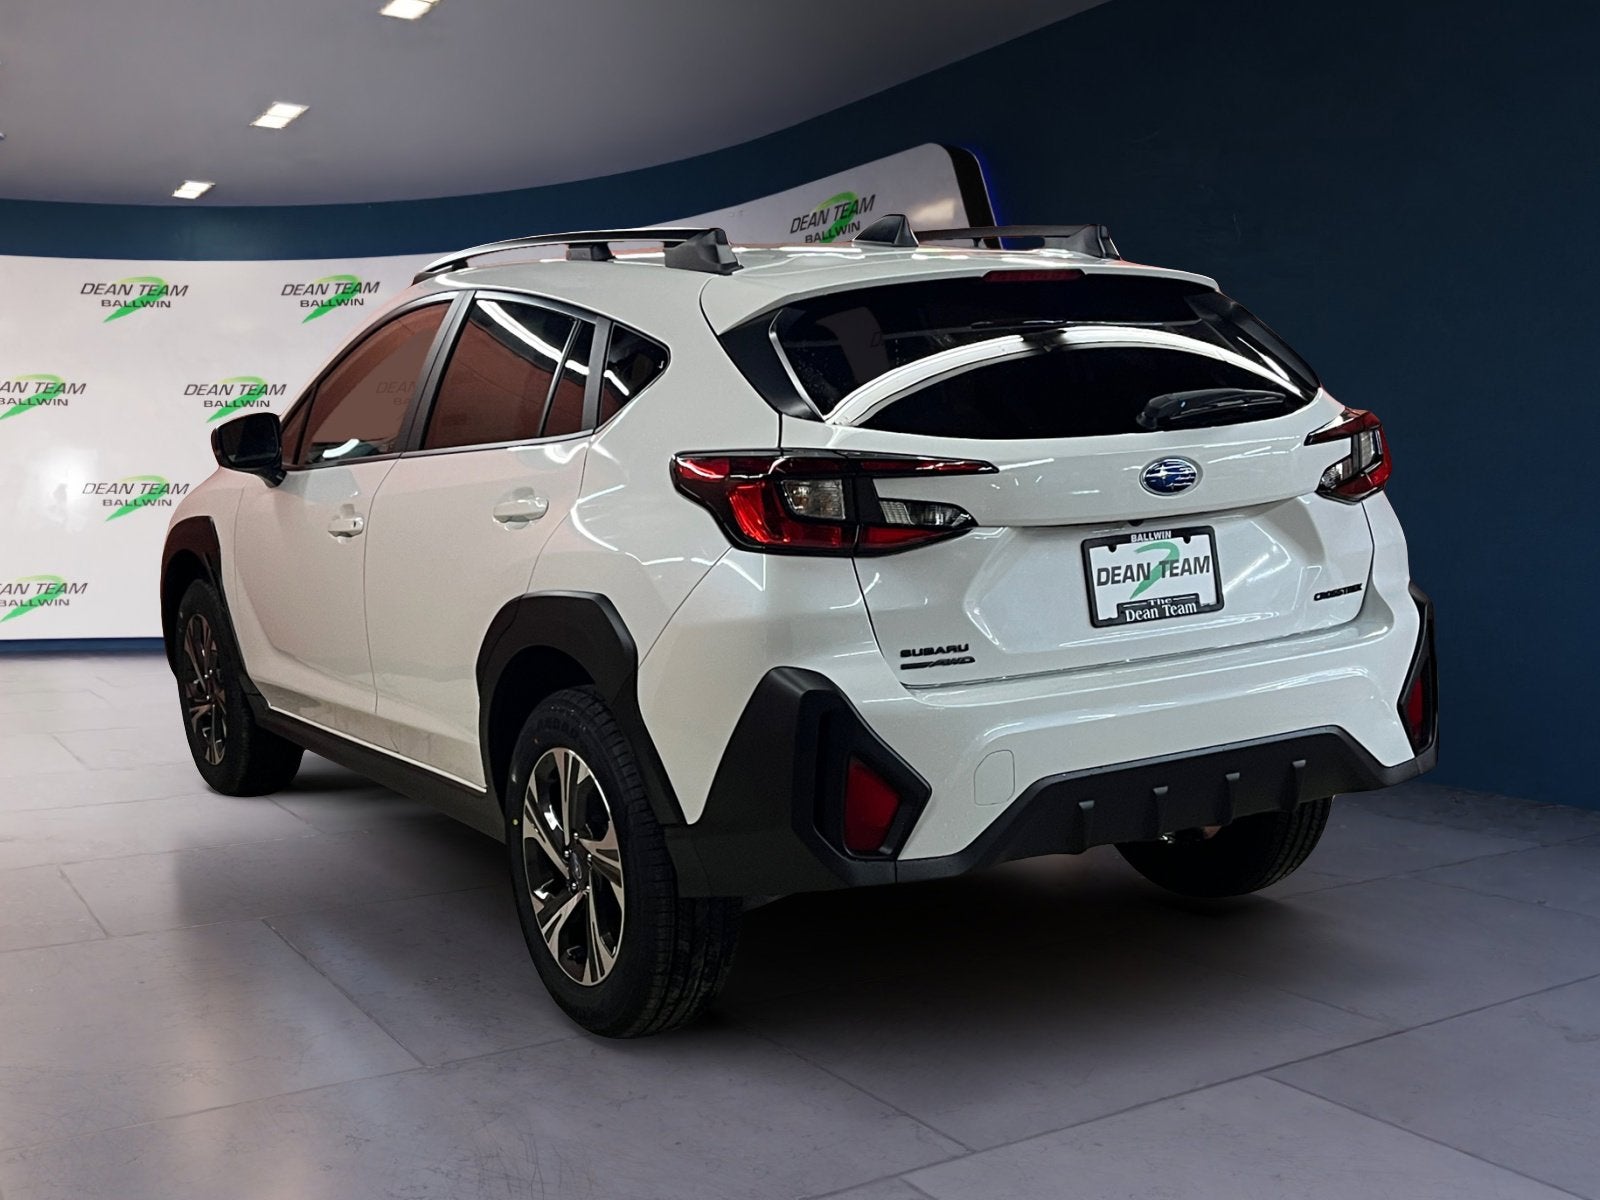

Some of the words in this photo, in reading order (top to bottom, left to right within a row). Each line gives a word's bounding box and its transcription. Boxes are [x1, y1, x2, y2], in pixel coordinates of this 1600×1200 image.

[790, 208, 830, 234] DEAN
[834, 194, 876, 221] TEAM
[805, 220, 861, 243] BALLWIN
[80, 282, 133, 296] DEAN
[139, 284, 189, 297] TEAM
[281, 283, 330, 296] DEAN
[334, 281, 380, 295] TEAM
[101, 299, 171, 308] BALLWIN
[300, 298, 364, 308] BALLWIN
[0, 381, 29, 394] AN
[34, 382, 87, 395] TEAM
[183, 383, 234, 396] DEAN
[239, 383, 287, 396] TEAM
[203, 400, 270, 408] BALLWIN
[82, 482, 135, 495] DEAN
[140, 483, 190, 495] TEAM
[102, 499, 172, 507] BALLWIN
[1130, 530, 1172, 543] BALLWIN
[1096, 561, 1151, 587] DEAN
[1158, 555, 1211, 579] TEAM
[0, 583, 31, 595] AN
[36, 582, 88, 595] TEAM
[1147, 597, 1173, 606] The
[1125, 607, 1160, 622] Dean
[1162, 602, 1198, 617] Team
[900, 643, 969, 658] SUBARU
